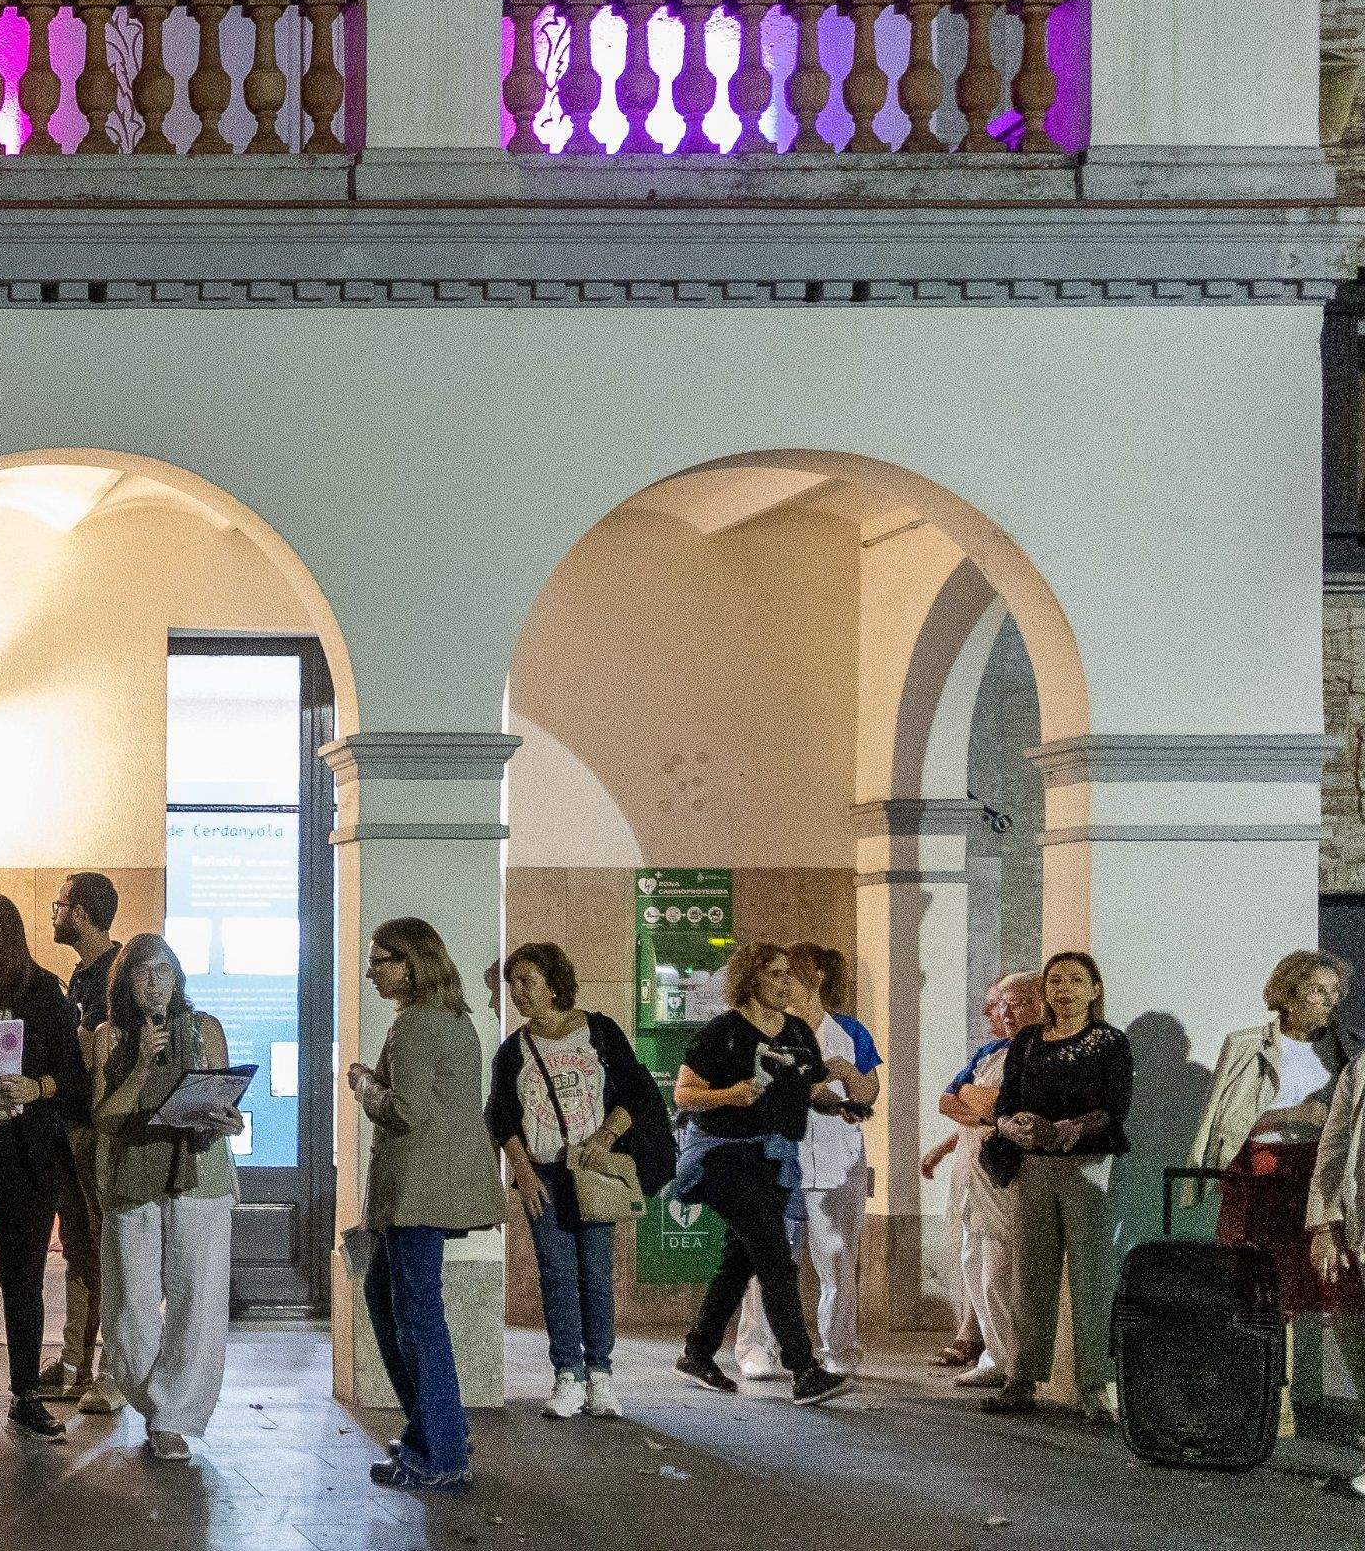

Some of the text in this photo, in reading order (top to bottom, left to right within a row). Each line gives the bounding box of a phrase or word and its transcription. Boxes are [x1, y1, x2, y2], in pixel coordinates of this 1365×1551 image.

[166, 823, 284, 840] de Cerdanyola
[669, 1237, 703, 1248] DEA
